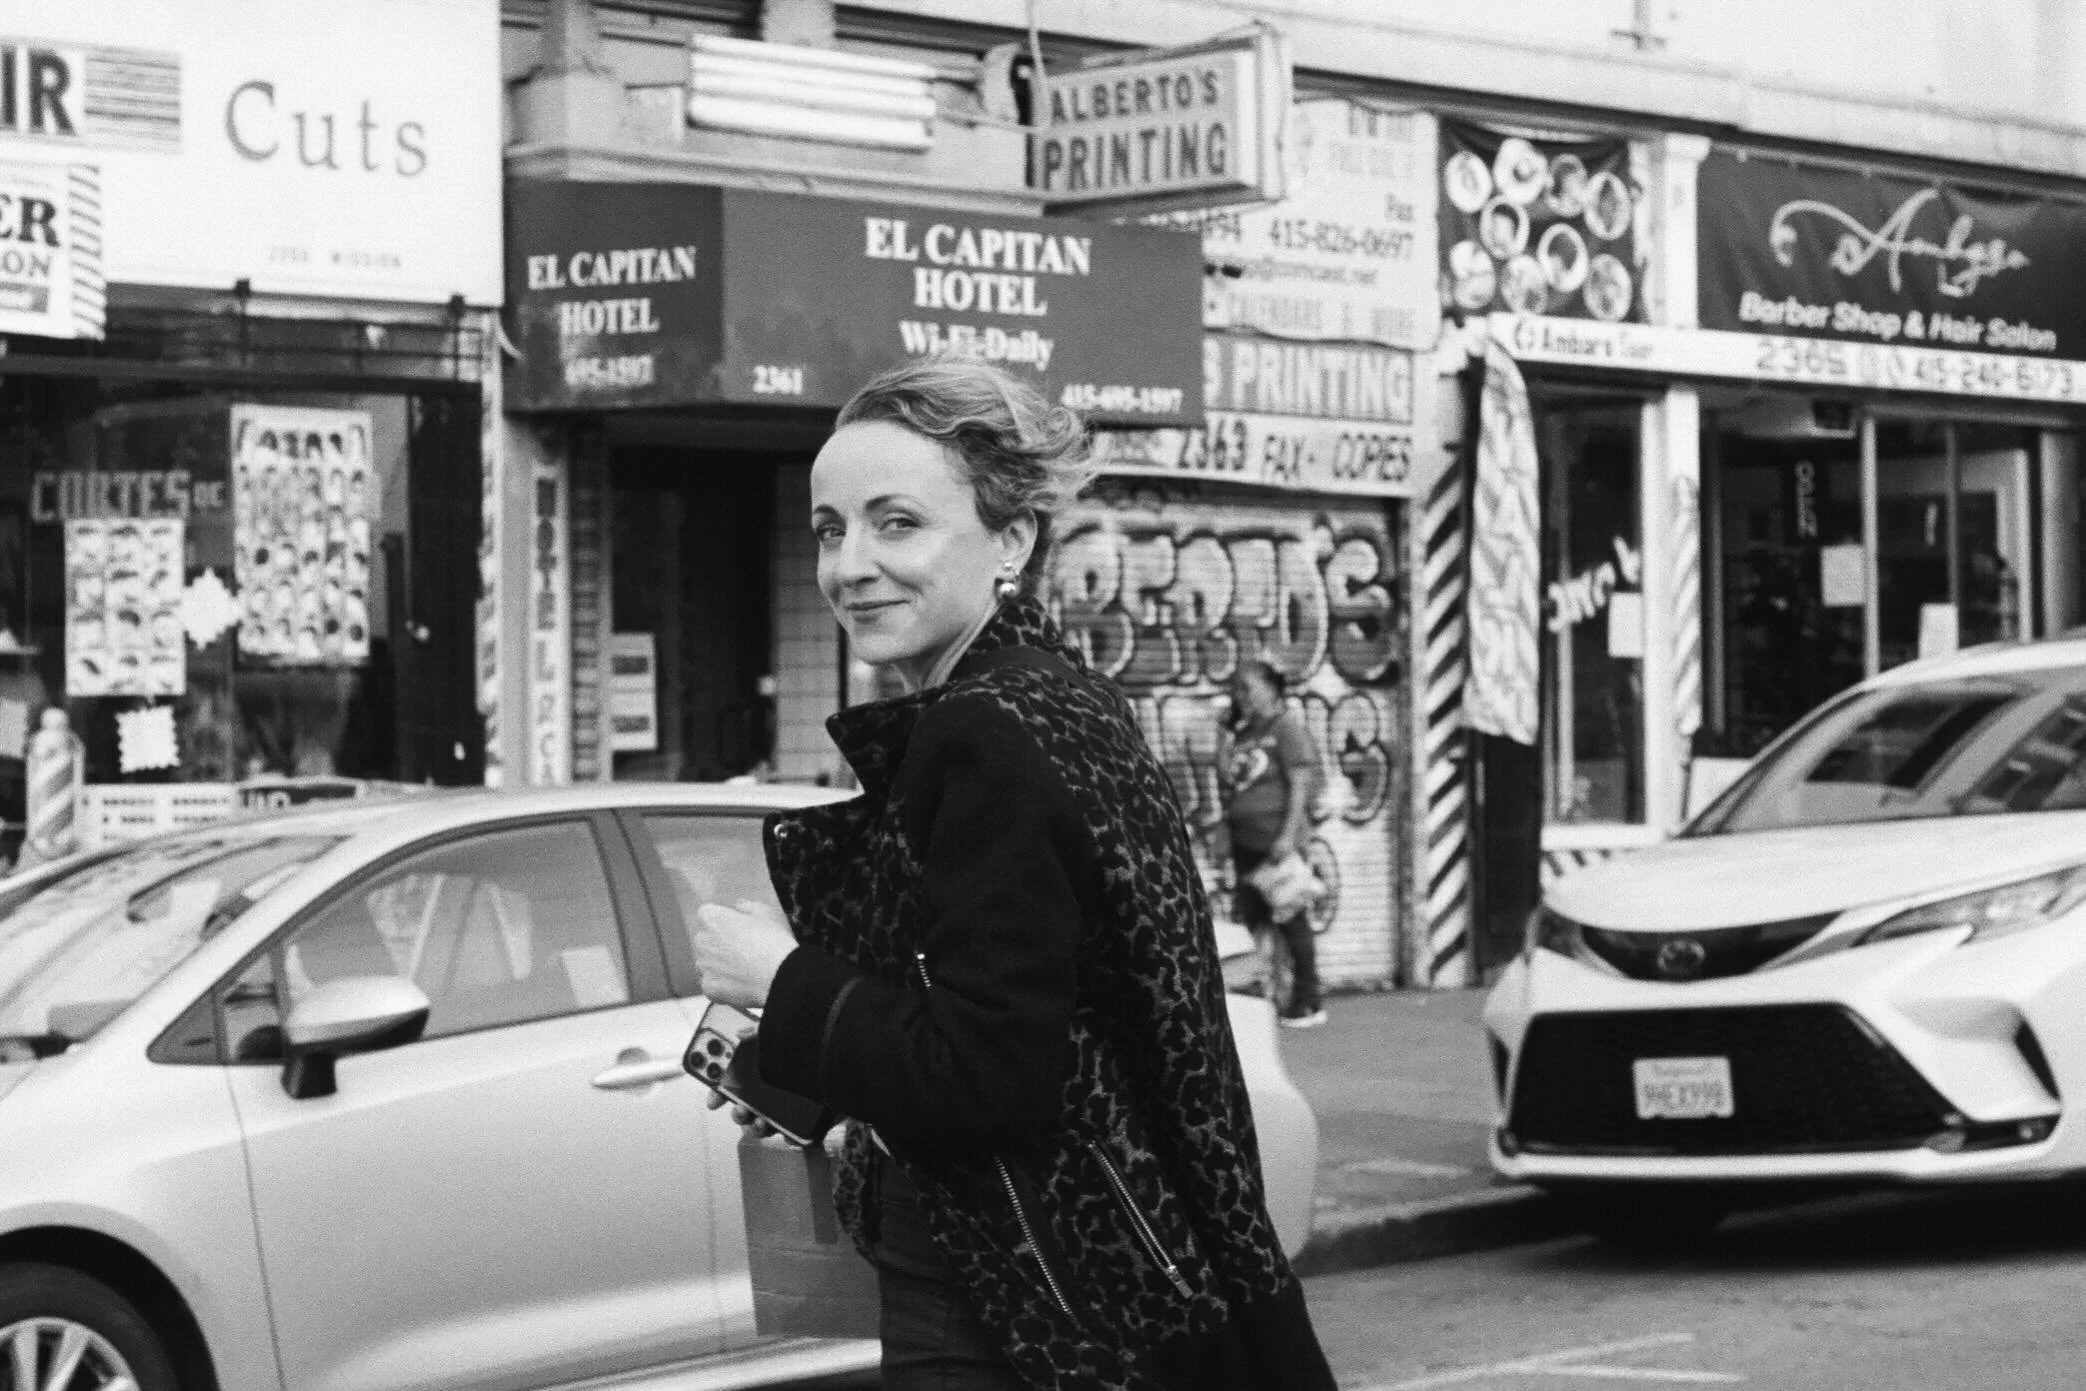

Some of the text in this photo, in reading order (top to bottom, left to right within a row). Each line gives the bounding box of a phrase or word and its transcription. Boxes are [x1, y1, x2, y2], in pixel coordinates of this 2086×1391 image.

[1051, 70, 1218, 124] ALBERTO'S
[226, 80, 427, 178] Cuts
[1043, 122, 1226, 190] PRINTING
[527, 245, 698, 290] EL CAPITAN
[864, 216, 1092, 276] EL CAPITAN
[558, 298, 661, 336] HOTEL
[914, 266, 1049, 316] HOTEL
[1739, 291, 2057, 351] Barber Shop & Hair Salon
[1233, 343, 1411, 422] PRINTING
